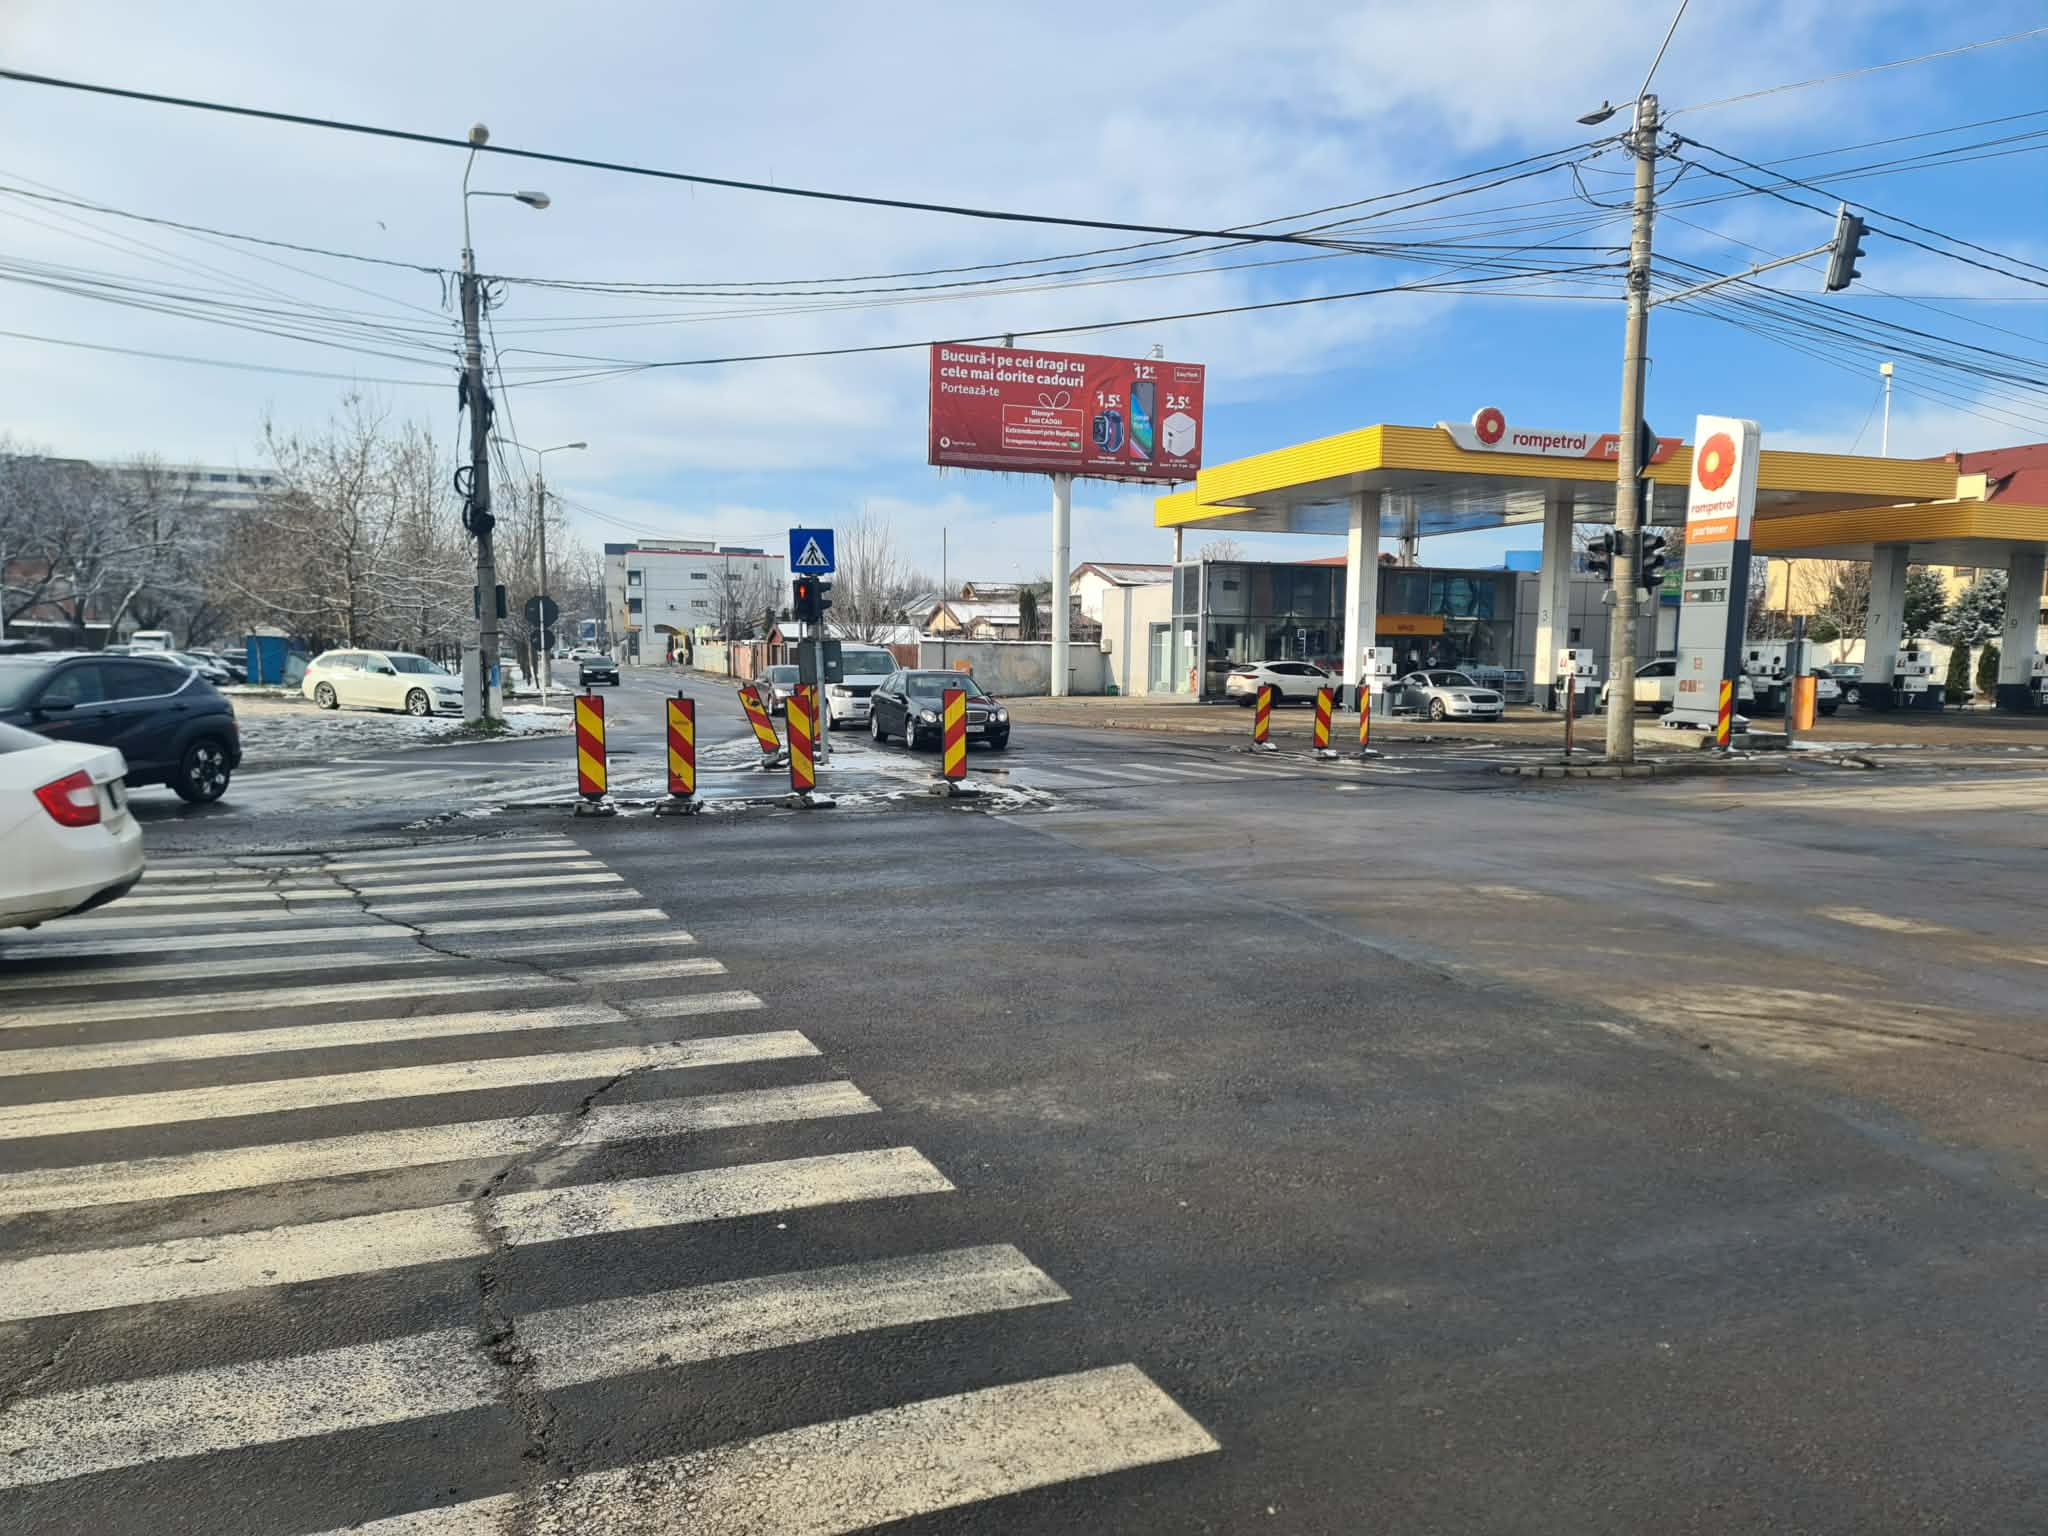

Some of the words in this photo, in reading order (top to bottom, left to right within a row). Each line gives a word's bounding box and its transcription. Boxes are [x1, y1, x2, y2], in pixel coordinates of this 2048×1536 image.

[941, 349, 995, 365] Bucură-i
[998, 356, 1013, 368] pe
[1015, 356, 1033, 368] cei
[1036, 357, 1068, 373] dragi
[1070, 362, 1085, 372] cu
[940, 366, 968, 378] cele
[970, 368, 994, 380] mai
[996, 369, 1034, 384] dorite
[1036, 373, 1084, 388] cadouri
[941, 382, 1000, 396] Portează-te
[1512, 433, 1587, 452] rompetrol
[1690, 497, 1735, 514] rompetrol
[1692, 525, 1729, 541] partener
